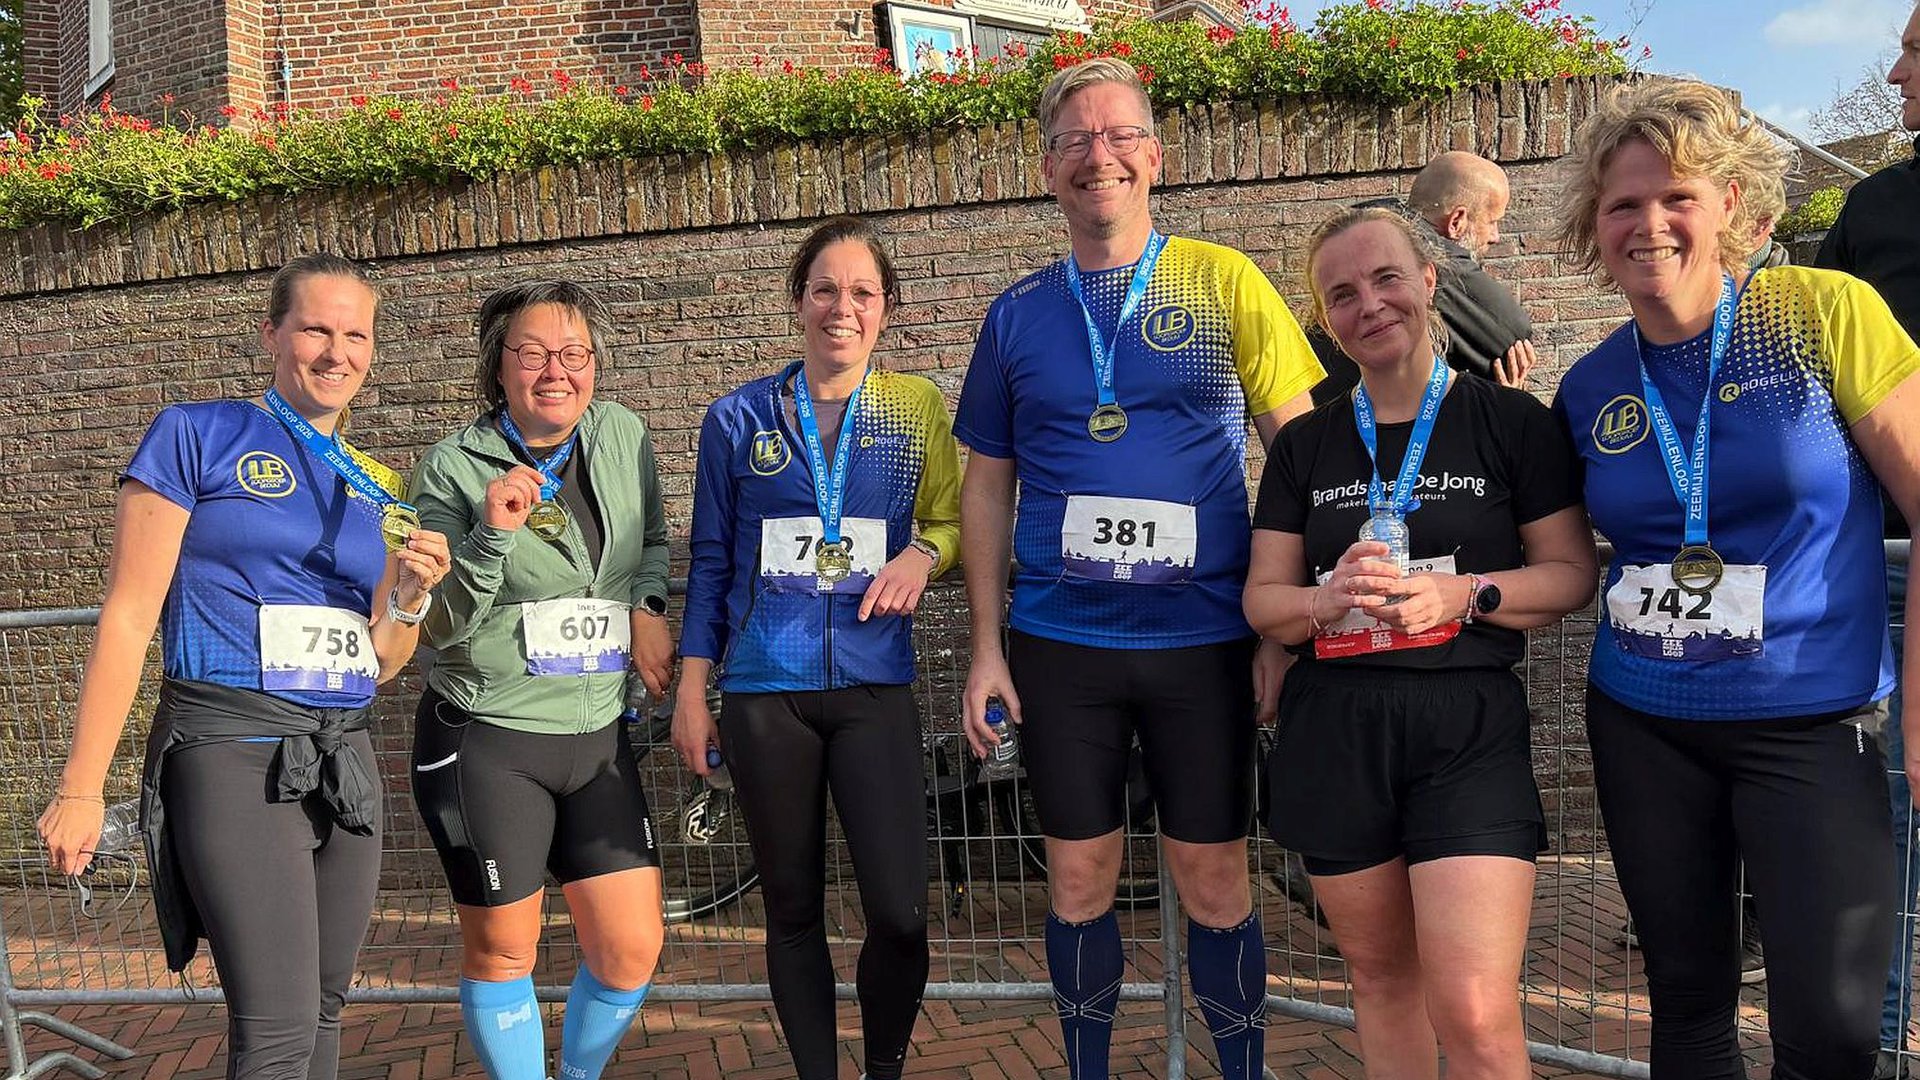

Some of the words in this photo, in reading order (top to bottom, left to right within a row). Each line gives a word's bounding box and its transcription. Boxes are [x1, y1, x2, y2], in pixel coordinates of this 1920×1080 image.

[1741, 368, 1799, 393] ROGELLI
[1422, 398, 1437, 421] 2026
[295, 421, 315, 440] 2026
[828, 453, 846, 527] ZEEMIJLENLOOP
[1093, 517, 1156, 548] 381
[1638, 586, 1713, 620] 742
[302, 626, 360, 658] 758
[560, 615, 609, 641] 607
[485, 859, 502, 891] FUSION
